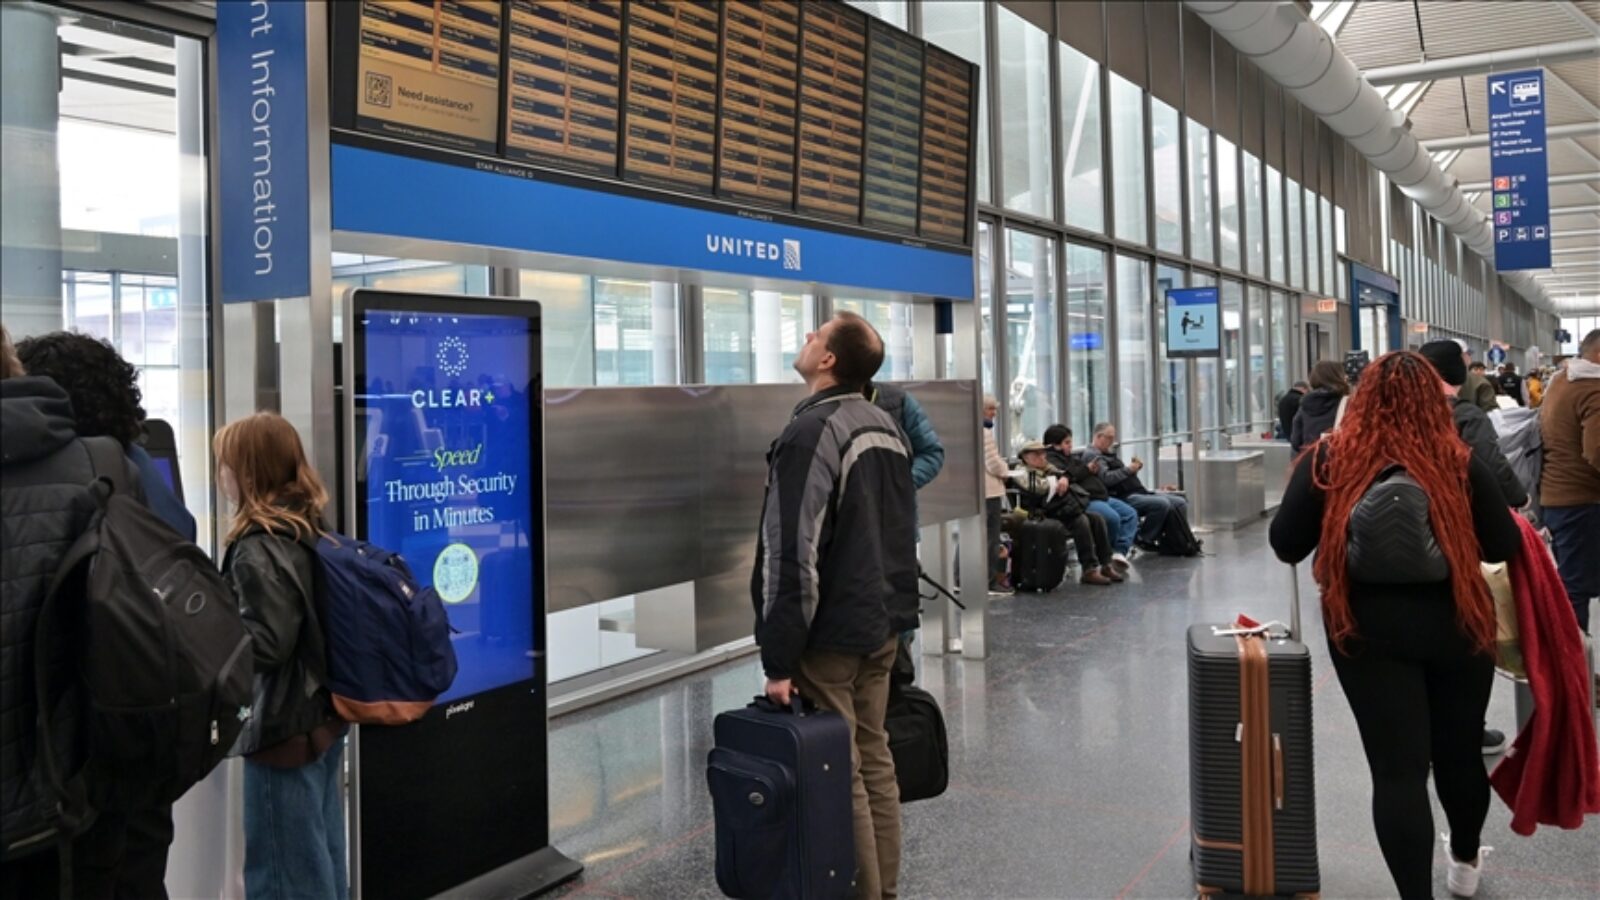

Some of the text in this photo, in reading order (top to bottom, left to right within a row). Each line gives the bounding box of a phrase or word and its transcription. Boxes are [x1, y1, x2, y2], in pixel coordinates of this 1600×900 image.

[398, 86, 423, 101] Need
[423, 93, 474, 112] assistance?
[251, 49, 278, 276] Information
[706, 234, 779, 260] UNITED
[430, 443, 483, 472] Speed
[385, 471, 518, 504] Through Security
[413, 506, 494, 532] in Minutes
